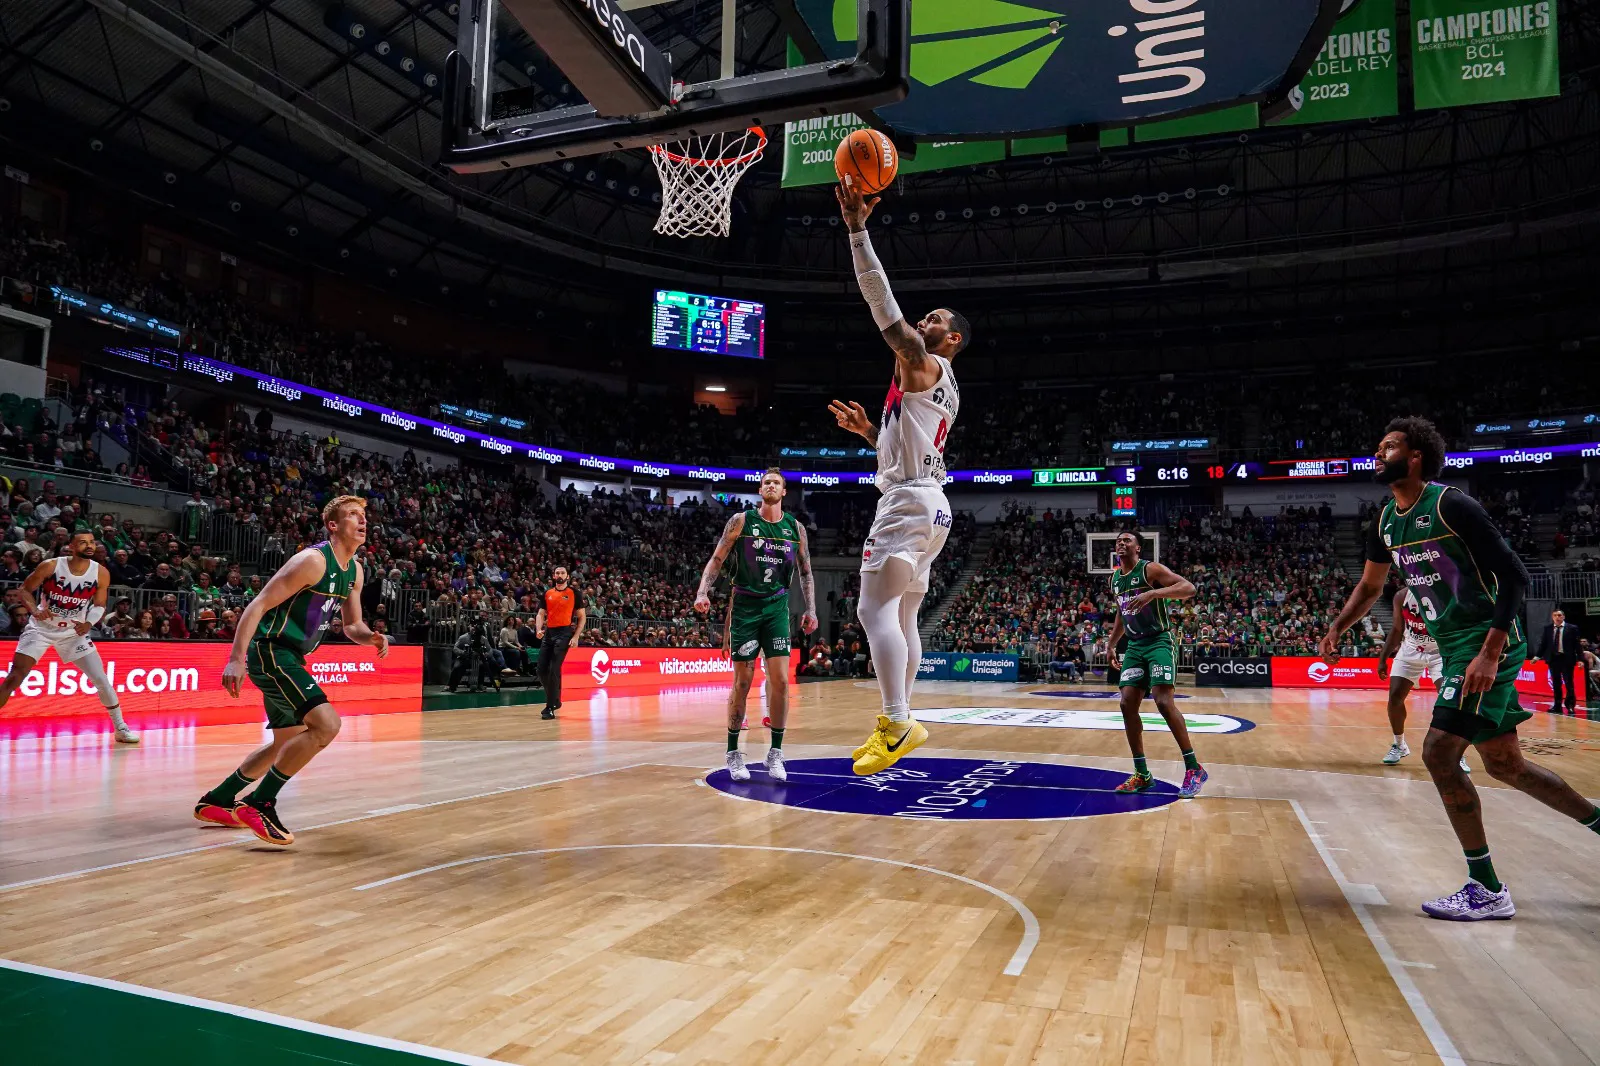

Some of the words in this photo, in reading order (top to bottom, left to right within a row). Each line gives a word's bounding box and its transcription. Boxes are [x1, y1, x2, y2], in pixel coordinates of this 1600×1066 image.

[1417, 1, 1550, 44] CAMPEONES
[580, 0, 645, 73] esa
[1418, 40, 1467, 52] BASKETBALL
[1471, 33, 1516, 45] CHAMPIONS
[1519, 27, 1551, 40] LEAGUE
[1315, 28, 1391, 61] PEONES
[1466, 44, 1504, 60] BCL
[1317, 59, 1351, 76] DEL
[1357, 54, 1393, 72] REY
[1461, 61, 1506, 80] 2024
[1310, 82, 1350, 100] 2023
[791, 131, 828, 145] COPA
[802, 149, 835, 165] 2000
[721, 302, 728, 310] 4
[701, 319, 721, 330] 6:16
[1486, 424, 1511, 432] Unicaja
[1540, 419, 1566, 428] Unicaja
[1445, 456, 1473, 468] laga
[1500, 450, 1552, 463] málaga
[633, 463, 670, 477] málaga
[1296, 461, 1325, 469] KOSNER
[1353, 460, 1376, 471] mál
[688, 468, 726, 481] málaga
[858, 473, 875, 485] mál
[973, 471, 1013, 485] málaga
[1056, 471, 1097, 483] UNICAJA
[1126, 468, 1136, 482] 5
[1157, 467, 1189, 480] 6:16
[1206, 466, 1224, 479] 18
[1236, 463, 1248, 479] 4
[1289, 468, 1326, 477] BASKONIA
[801, 473, 839, 486] málaga
[1115, 496, 1133, 509] 18
[765, 542, 791, 553] Unicaja
[755, 554, 783, 565] málaga
[1401, 549, 1441, 565] Unicaja
[763, 568, 772, 583] 2
[1421, 596, 1437, 621] 3
[312, 662, 341, 672] COSTA
[342, 662, 358, 672] DEL
[360, 662, 375, 672] SOL
[633, 659, 641, 667] SOL
[659, 656, 734, 675] visitacostadelsol.
[919, 657, 947, 666] dación
[972, 658, 1014, 667] Fundación
[1198, 660, 1268, 675] endesa
[917, 664, 935, 673] caja
[972, 666, 1003, 675] Unicaja
